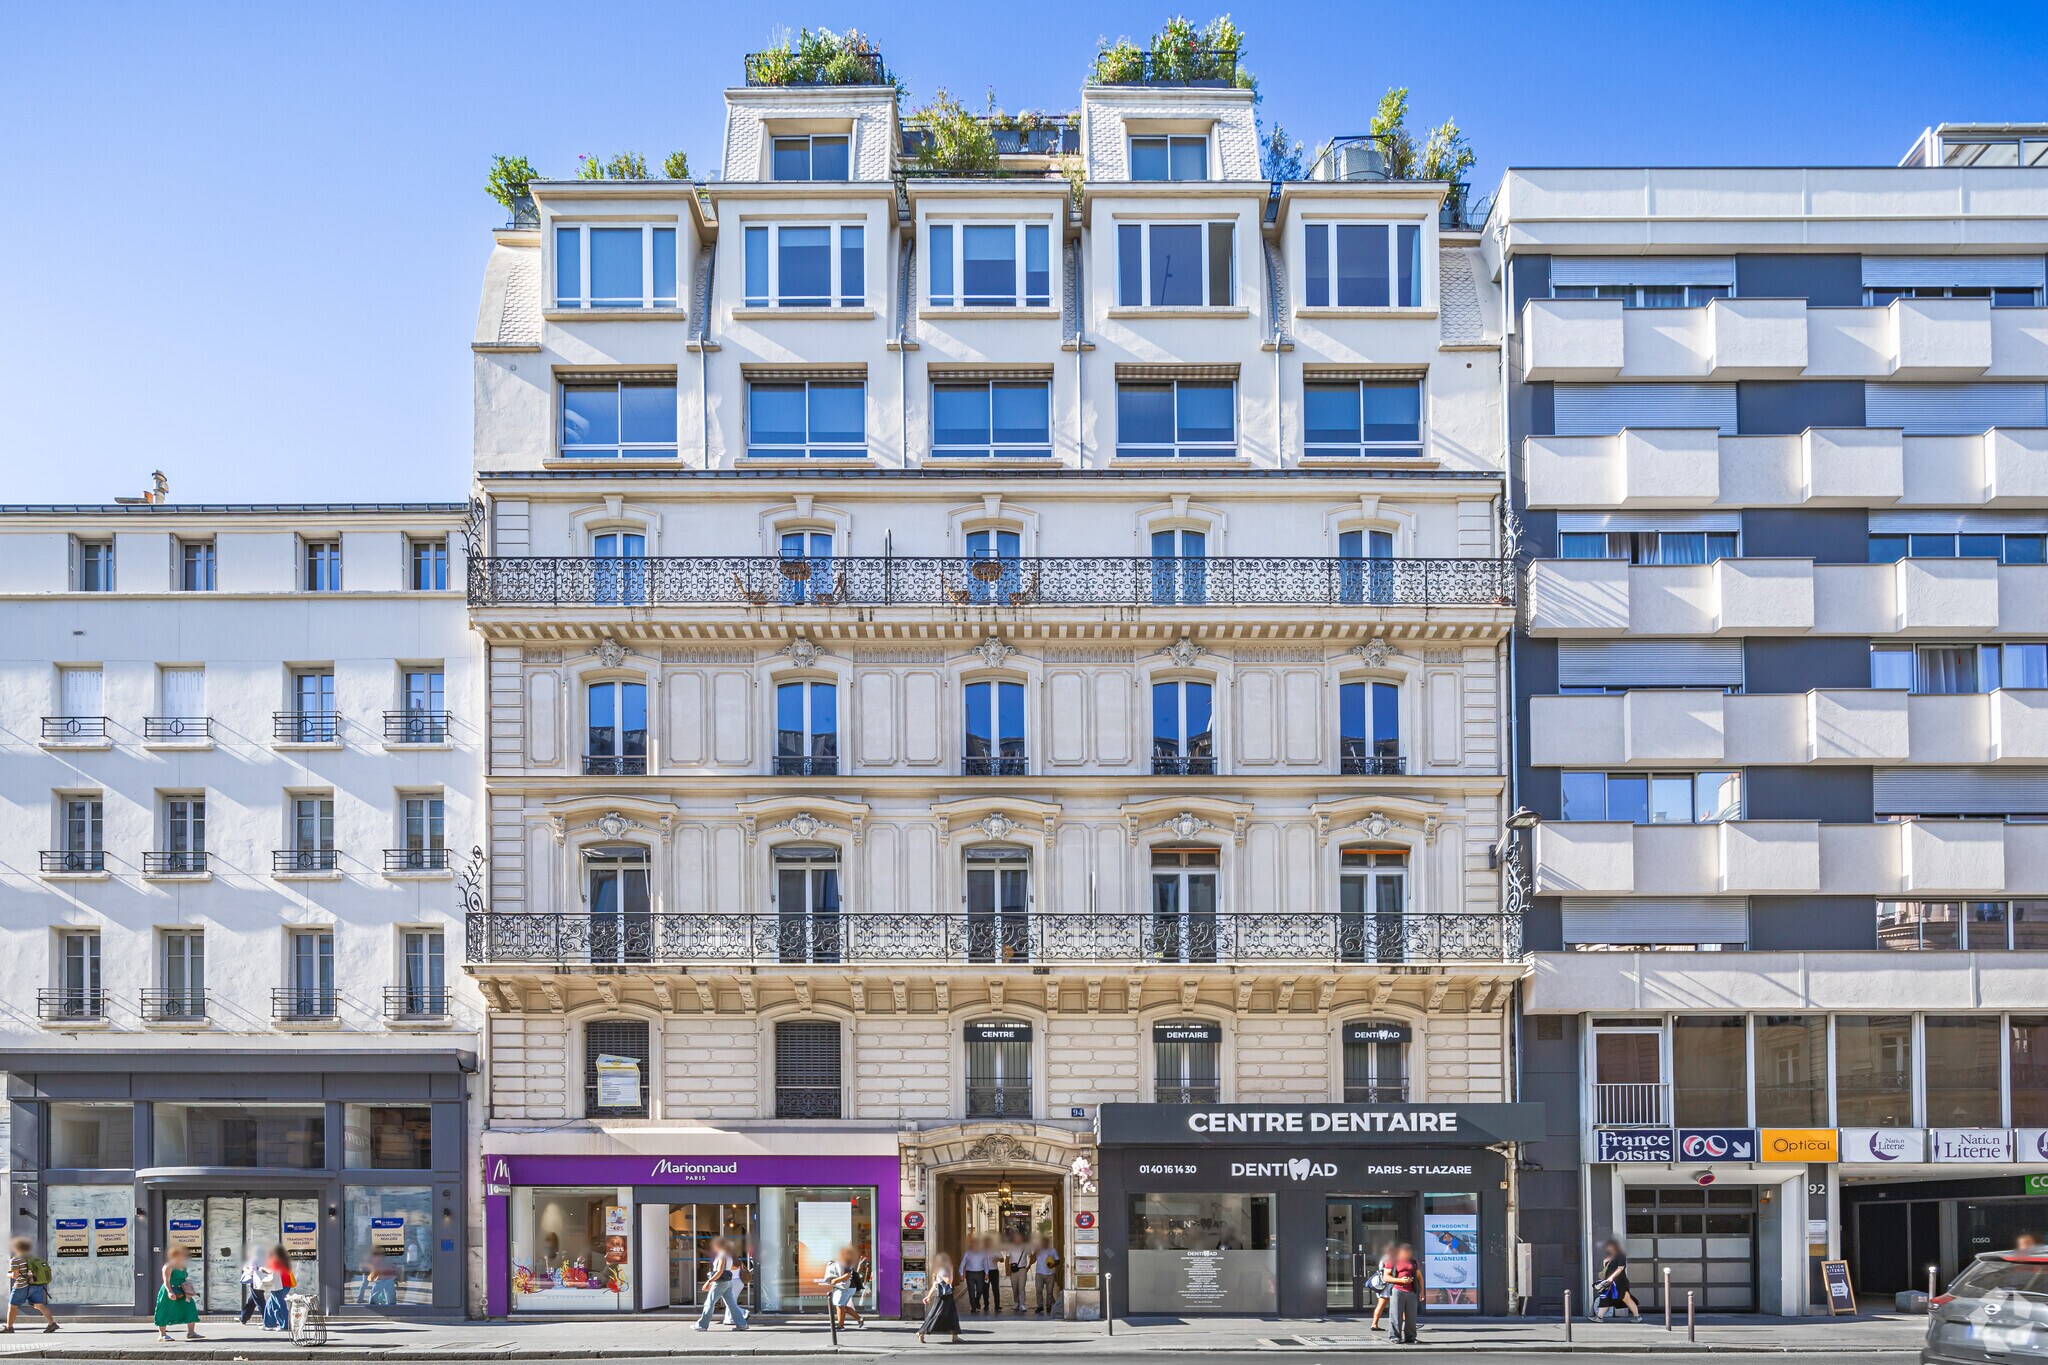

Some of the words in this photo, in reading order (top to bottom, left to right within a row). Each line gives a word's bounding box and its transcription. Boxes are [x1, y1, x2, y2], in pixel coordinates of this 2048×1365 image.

[1166, 1031, 1209, 1039] DENTAIRE
[1072, 1108, 1083, 1117] 94
[1188, 1112, 1304, 1132] CENTRE
[1310, 1112, 1458, 1132] DENTAIRE
[1600, 1131, 1671, 1147] France
[1773, 1138, 1830, 1152] Optical
[1960, 1134, 2001, 1145] Nation
[1878, 1142, 1905, 1150] Literie
[1944, 1142, 2001, 1158] Literie
[1600, 1146, 1671, 1161] Loisirs
[650, 1158, 737, 1177] Marionnaud
[1139, 1165, 1150, 1174] 01
[1150, 1165, 1163, 1174] 40
[1163, 1165, 1174, 1174] 16
[1174, 1165, 1184, 1174] 14
[1184, 1165, 1197, 1174] 30
[1367, 1165, 1403, 1175] PARIS
[1409, 1165, 1425, 1175] ST
[1425, 1165, 1472, 1175] LAZARE
[1808, 1183, 1826, 1195] 92
